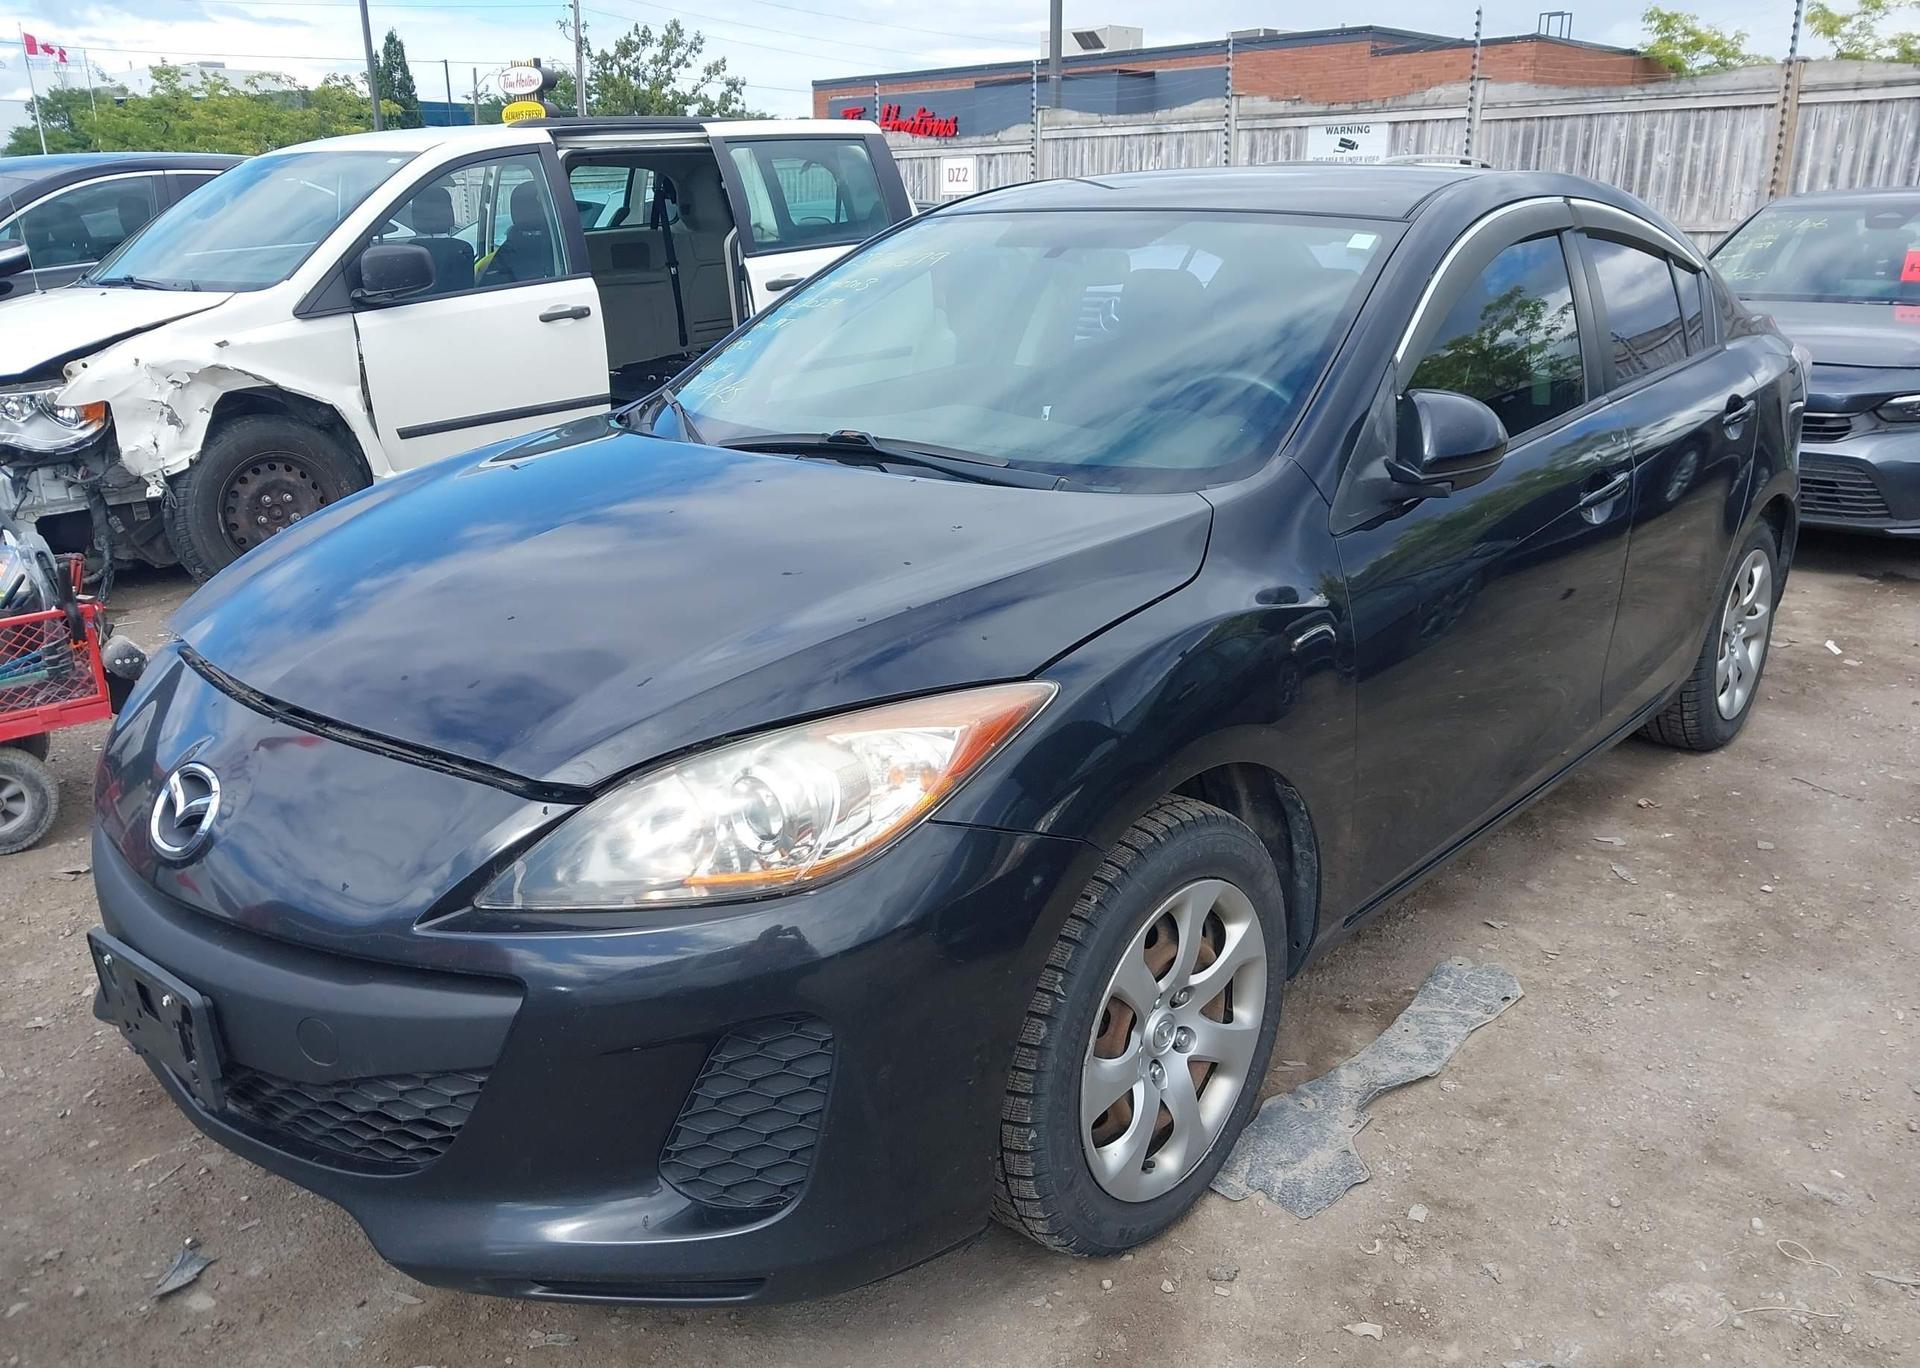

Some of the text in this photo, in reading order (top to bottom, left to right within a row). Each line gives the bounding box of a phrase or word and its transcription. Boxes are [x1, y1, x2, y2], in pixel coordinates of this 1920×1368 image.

[502, 72, 540, 90] Tim Hortons
[505, 109, 543, 121] ALWAYS FRESH
[880, 103, 958, 137] Hortons
[1325, 125, 1371, 135] WARNING
[948, 167, 969, 183] DZ2
